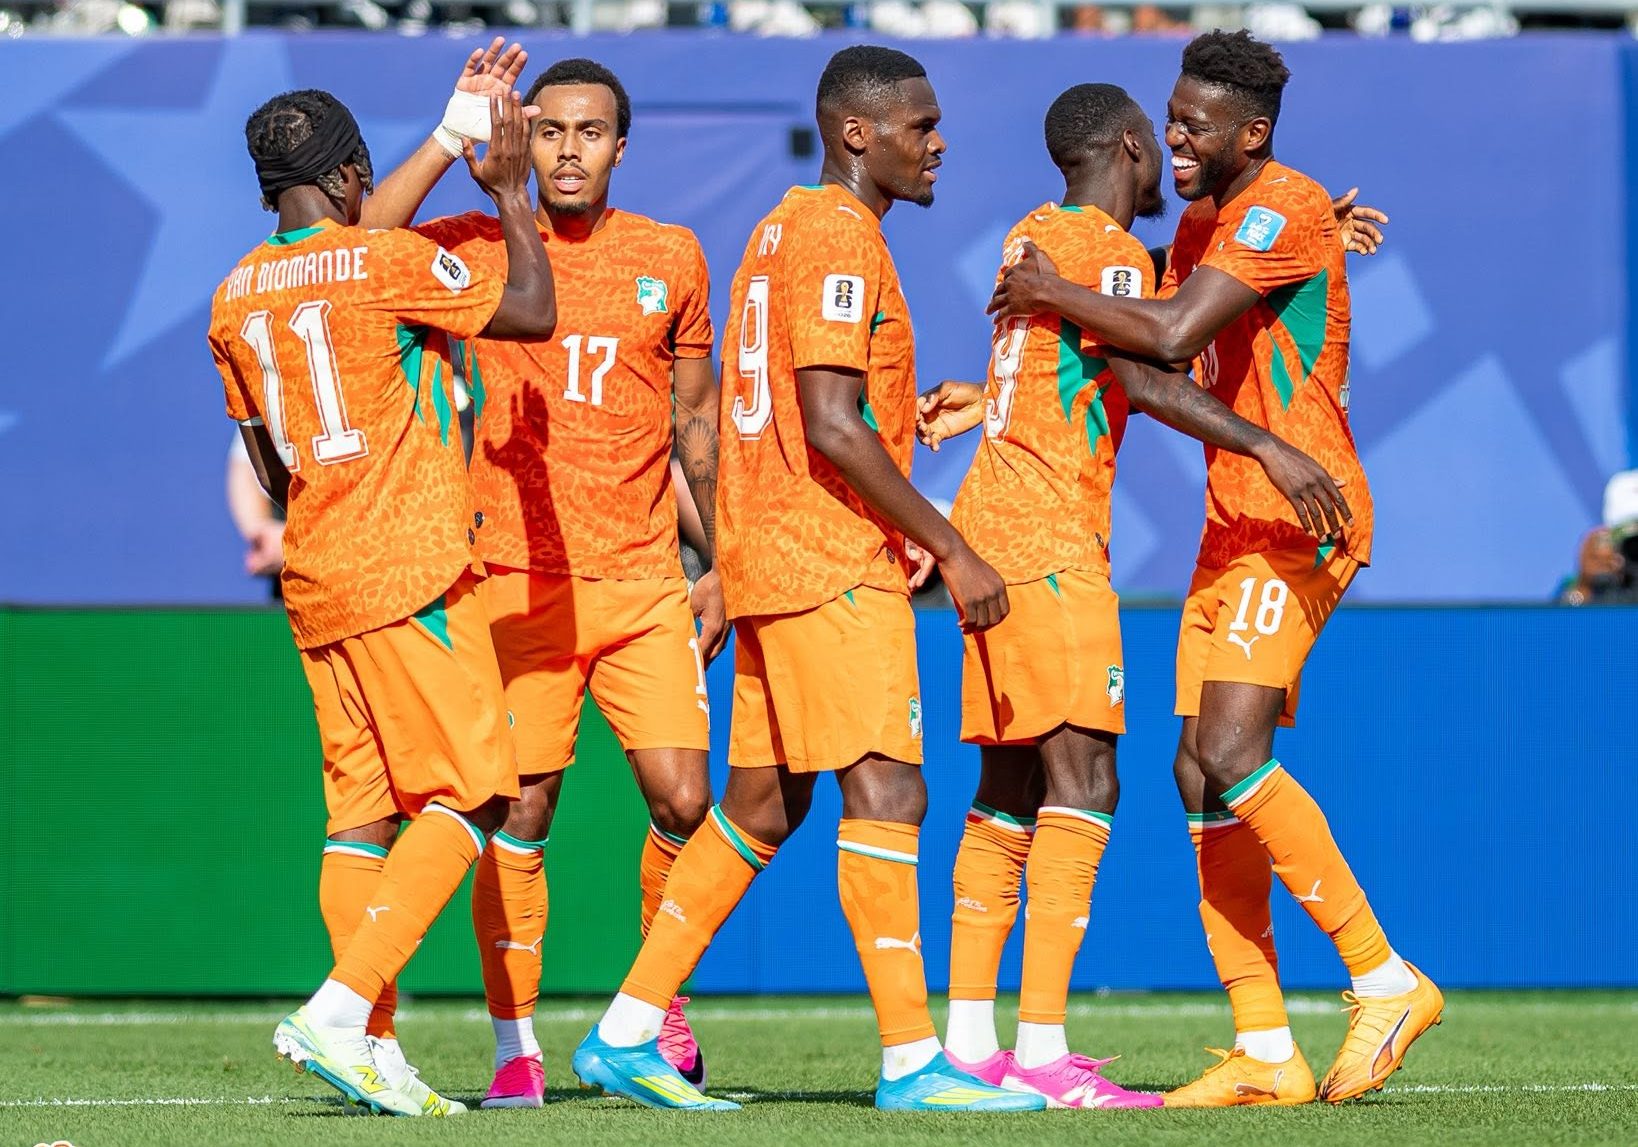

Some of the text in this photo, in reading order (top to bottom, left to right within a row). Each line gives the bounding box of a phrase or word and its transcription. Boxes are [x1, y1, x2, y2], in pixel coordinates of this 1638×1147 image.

[256, 246, 369, 294] DIOMANDE
[240, 299, 369, 473] 11
[561, 334, 621, 407] 17
[731, 275, 774, 441] 9
[1229, 577, 1289, 636] 18
